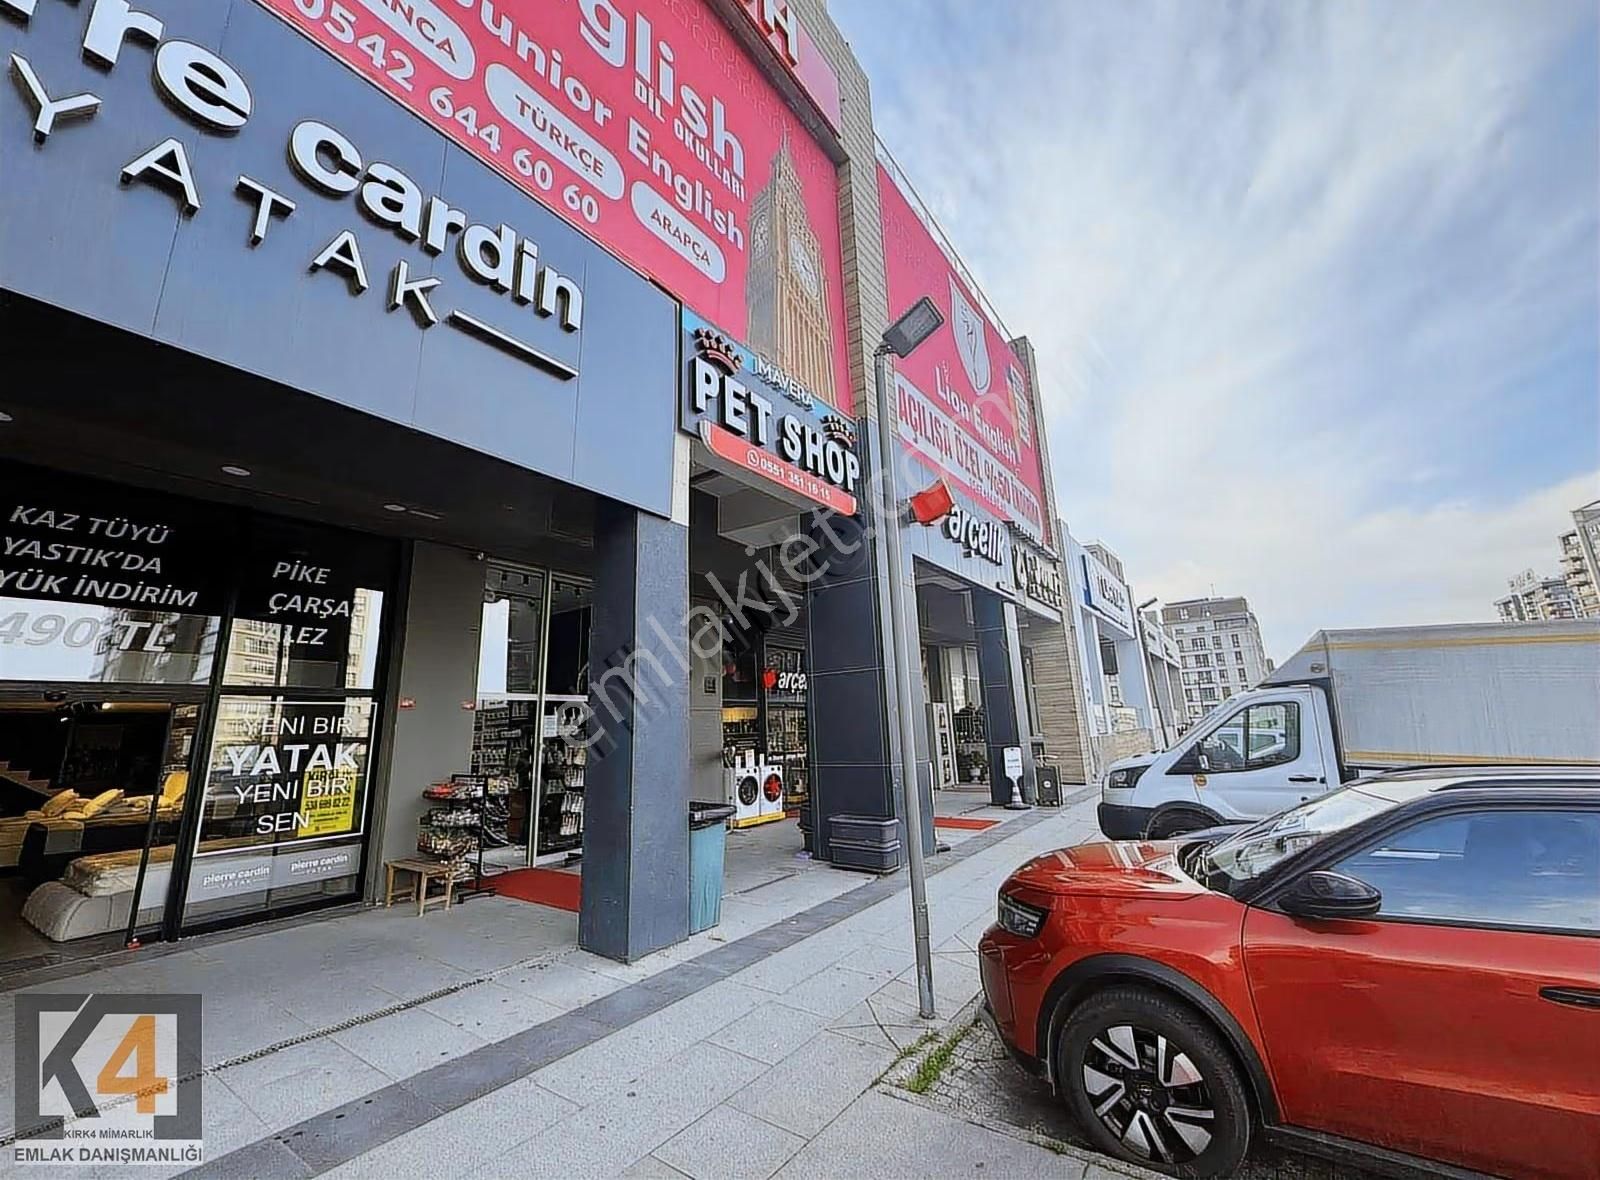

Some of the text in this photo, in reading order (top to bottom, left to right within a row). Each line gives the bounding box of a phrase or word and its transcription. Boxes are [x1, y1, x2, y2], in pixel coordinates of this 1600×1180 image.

[382, 0, 456, 63] NCA
[455, 0, 744, 251] unior English
[514, 93, 604, 178] TÜRKÇE
[634, 77, 746, 203] DİL OKULLARI
[0, 0, 583, 332] re cardin
[429, 87, 501, 153] 644
[512, 149, 553, 191] 60
[563, 184, 600, 224] 60
[10, 52, 442, 326] YATAK
[649, 208, 712, 267] ARAPÇA
[935, 365, 970, 422] Lion
[694, 357, 861, 493] PET SHOP
[9, 505, 169, 544] KAZ TÜYÜ
[948, 503, 1005, 565] arçelik
[72, 574, 198, 607] İNDİRİM
[272, 560, 331, 584] PİKE
[116, 619, 169, 652] TL
[268, 593, 354, 620] ÇARŞA
[226, 742, 361, 776] YATAK
[256, 811, 310, 834] SEN
[203, 865, 270, 887] pierre cardin
[291, 853, 348, 872] pierre cardin
